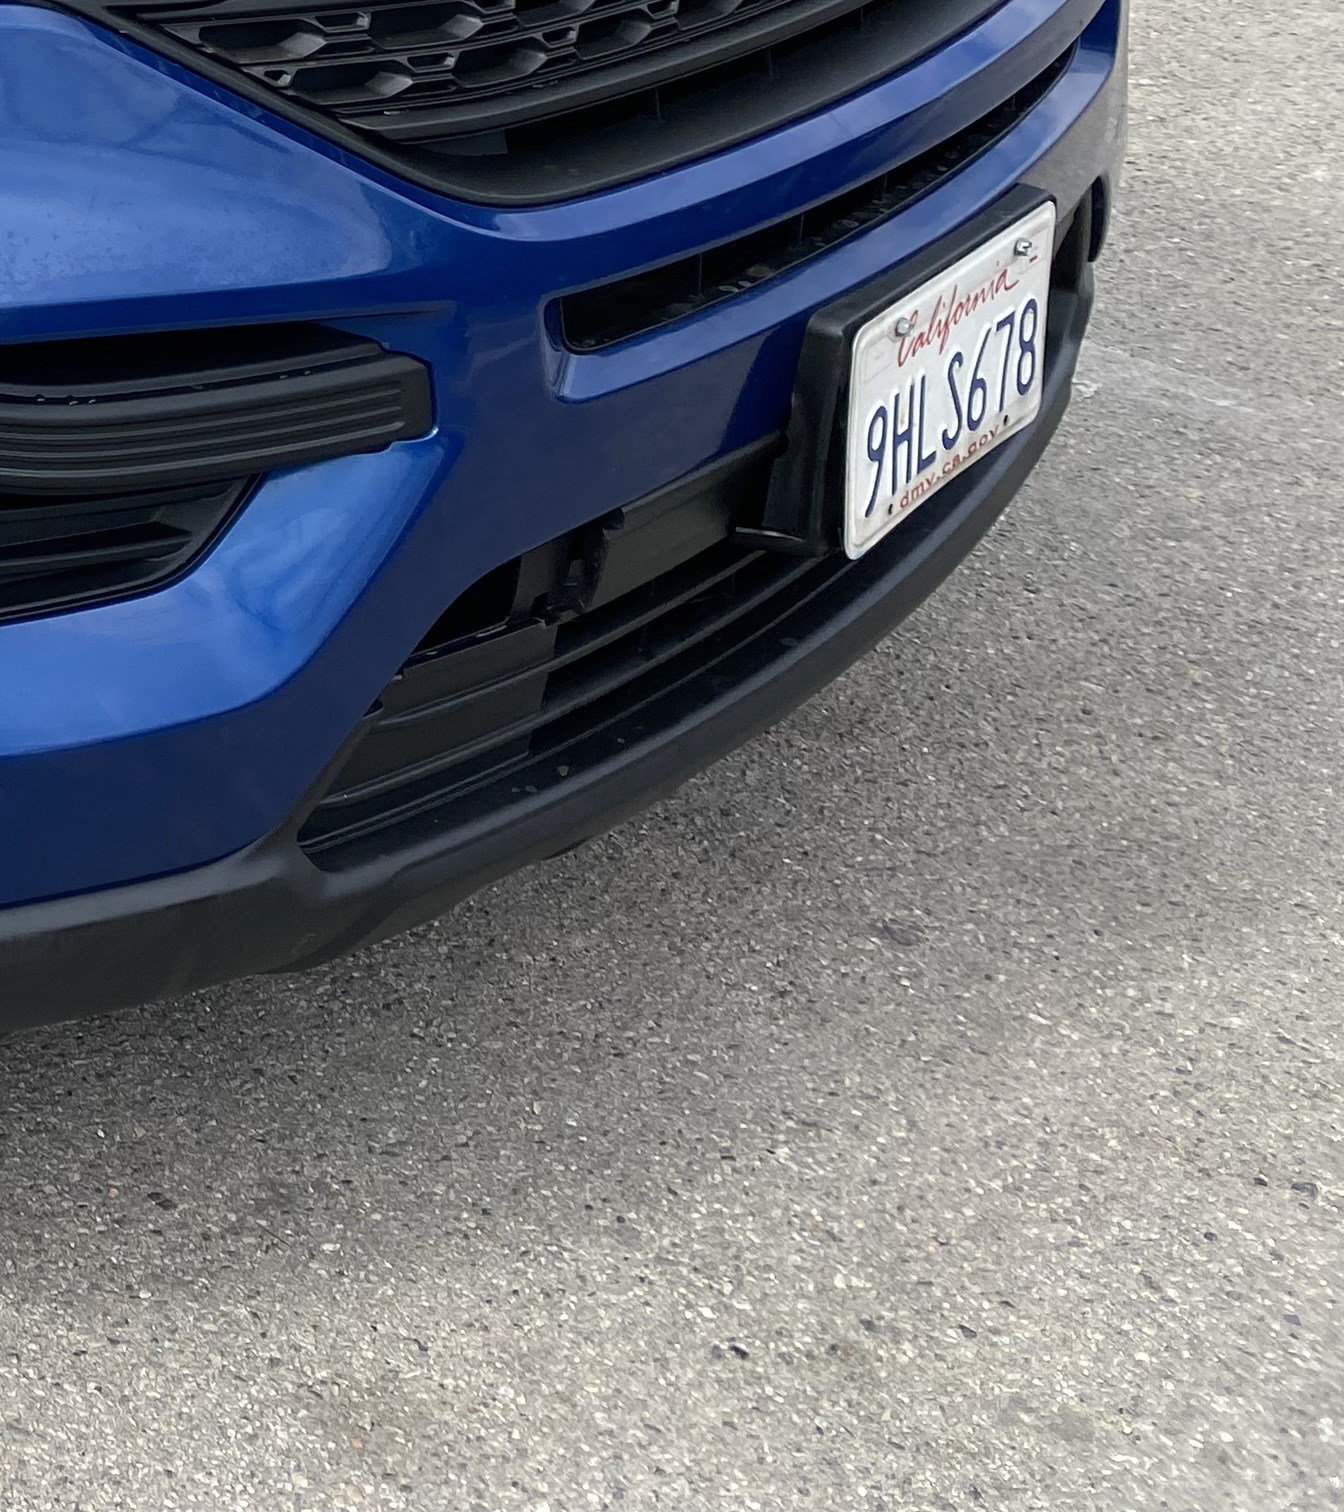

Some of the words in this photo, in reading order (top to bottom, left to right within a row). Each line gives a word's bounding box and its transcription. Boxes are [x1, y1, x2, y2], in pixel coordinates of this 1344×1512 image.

[898, 260, 1019, 368] California
[864, 298, 1038, 518] 9HLS678
[899, 423, 1000, 508] dmv.ca.gov
